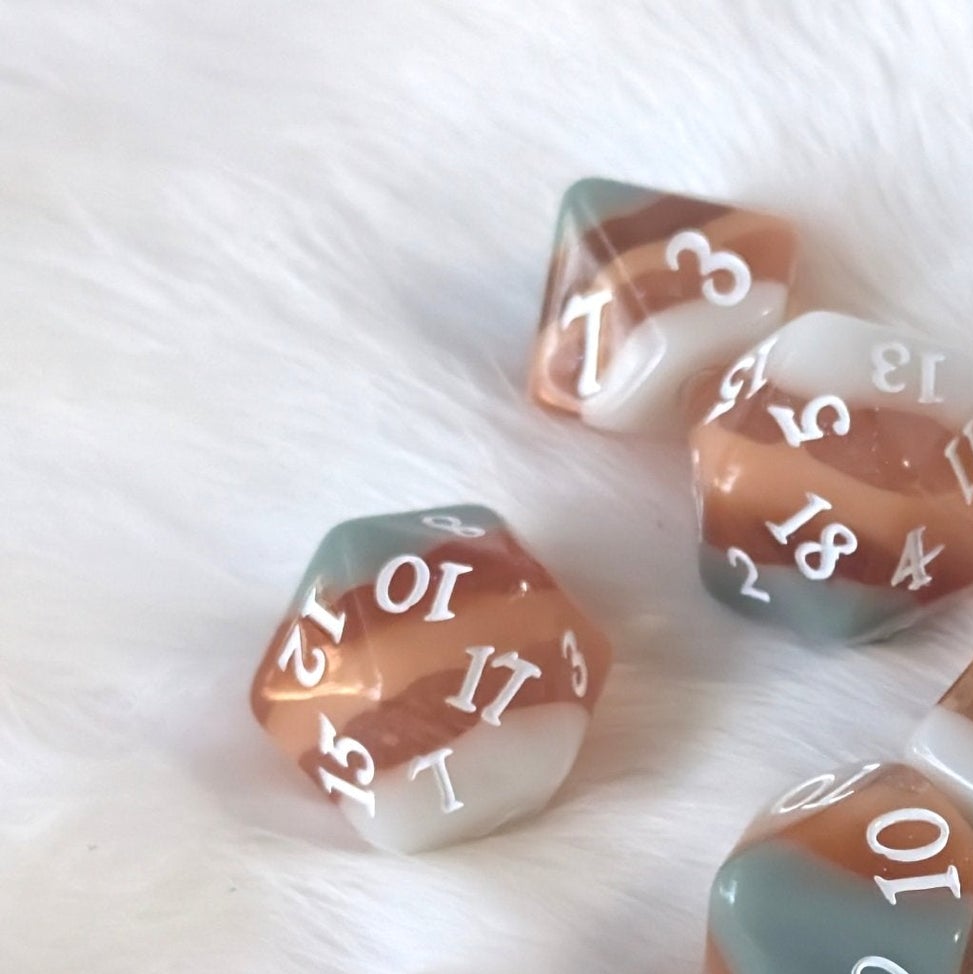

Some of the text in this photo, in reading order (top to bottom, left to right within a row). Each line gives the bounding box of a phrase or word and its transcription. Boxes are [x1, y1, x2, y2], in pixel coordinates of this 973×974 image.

[666, 230, 751, 306] 3
[871, 342, 947, 403] 13
[767, 394, 851, 447] 5
[765, 492, 858, 580] 18
[890, 525, 946, 591] 4
[375, 554, 474, 621] 10
[727, 547, 771, 603] 2
[277, 575, 346, 688] 12
[317, 713, 376, 818] 15
[866, 807, 962, 906] 10
